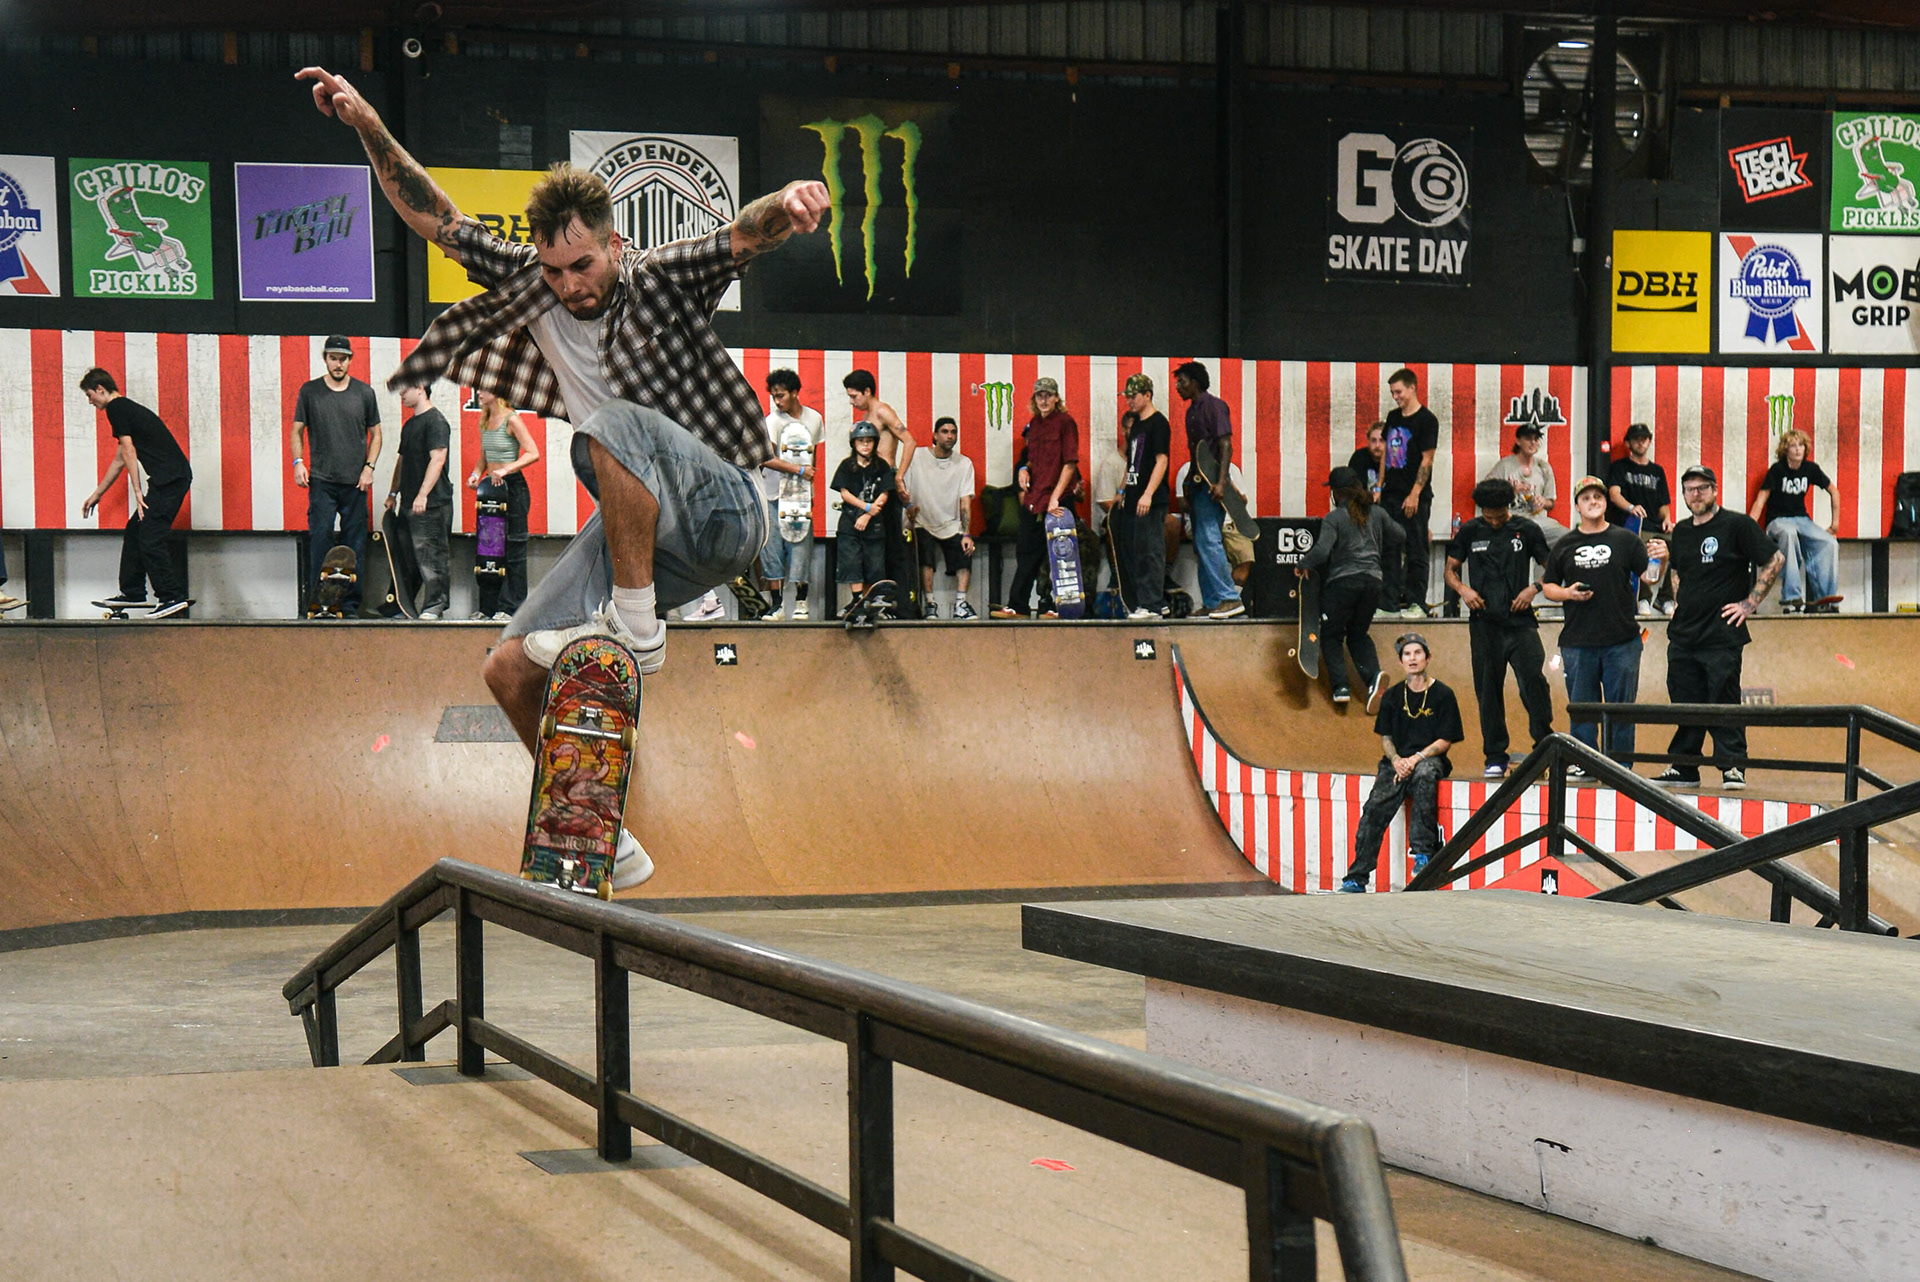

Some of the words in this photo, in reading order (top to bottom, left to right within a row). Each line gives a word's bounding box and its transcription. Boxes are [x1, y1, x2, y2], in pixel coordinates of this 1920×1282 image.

[1735, 142, 1790, 178] TECH
[76, 165, 203, 201] GRILLO'S
[1746, 161, 1803, 196] DECK
[0, 210, 38, 230] bon
[250, 193, 349, 241] TAMPA
[463, 213, 535, 243] BH
[1845, 209, 1920, 227] PICKLES
[293, 206, 361, 254] BAY
[1328, 234, 1410, 272] SKATE
[1418, 238, 1468, 275] DAY
[1750, 253, 1790, 278] Pabst
[92, 272, 195, 292] PICKLES
[266, 285, 349, 293] raysbaseball.com
[1617, 271, 1698, 296] DBH
[1731, 280, 1762, 297] Blue
[1763, 279, 1809, 297] Ribbon
[1832, 266, 1920, 303] MOB
[1852, 305, 1911, 326] GRIP
[1276, 553, 1298, 564] SKATE
[1574, 544, 1612, 560] 30
